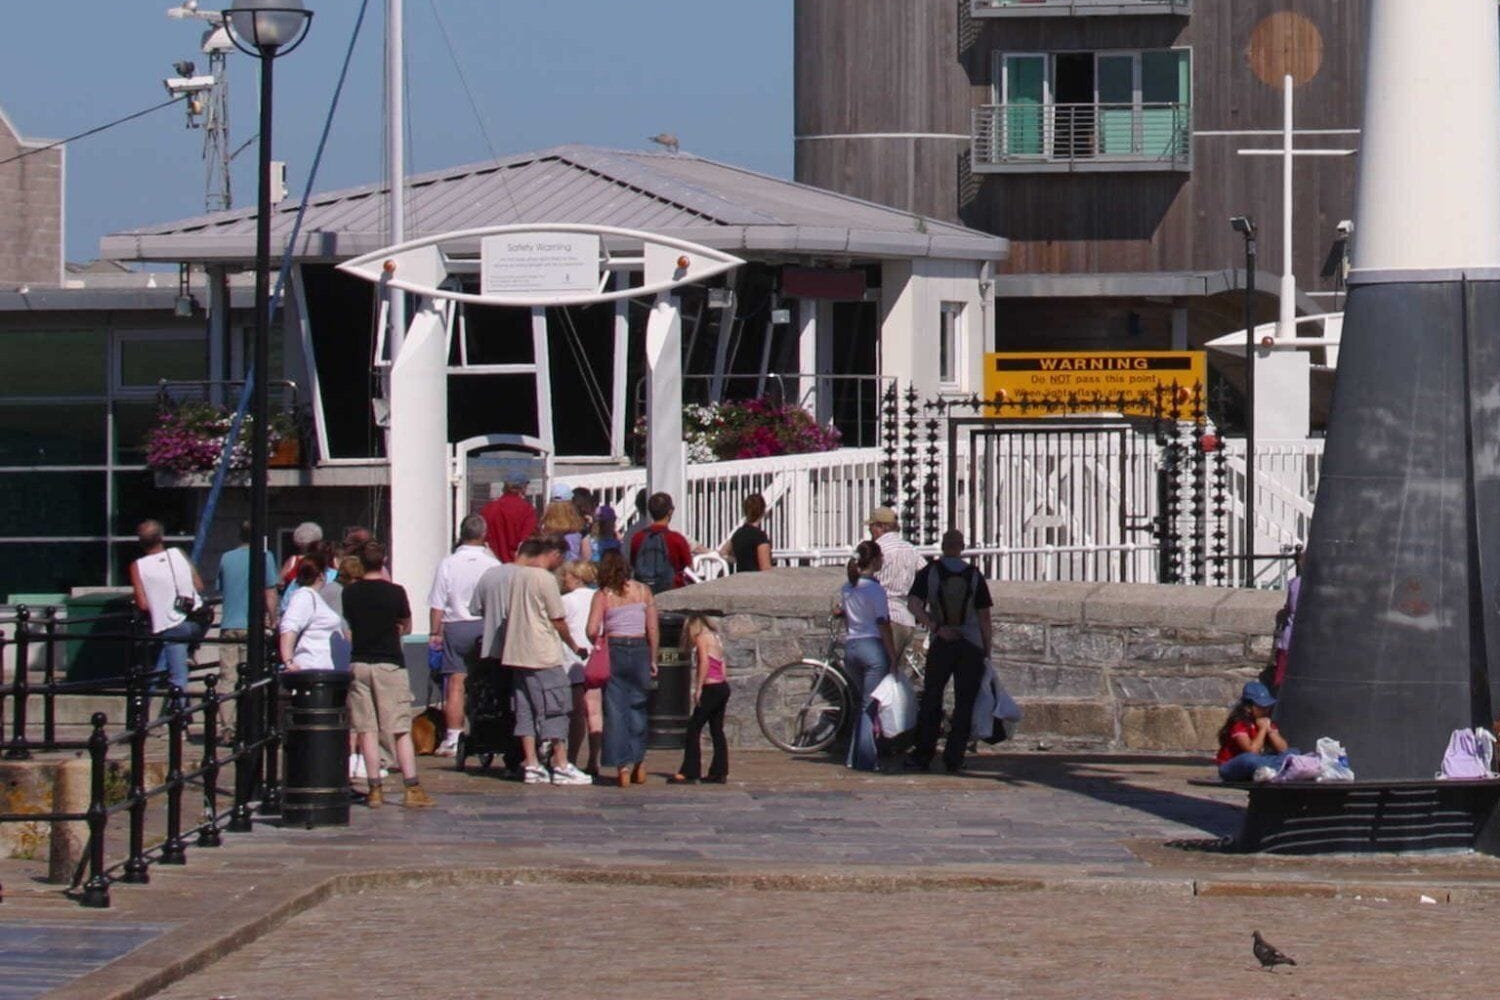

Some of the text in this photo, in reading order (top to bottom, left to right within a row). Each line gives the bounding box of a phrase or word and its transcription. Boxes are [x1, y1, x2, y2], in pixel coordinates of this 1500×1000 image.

[507, 242, 572, 253] Safety Warning
[1039, 358, 1149, 370] WARNING
[1031, 374, 1156, 385] Do NOT pass this point
